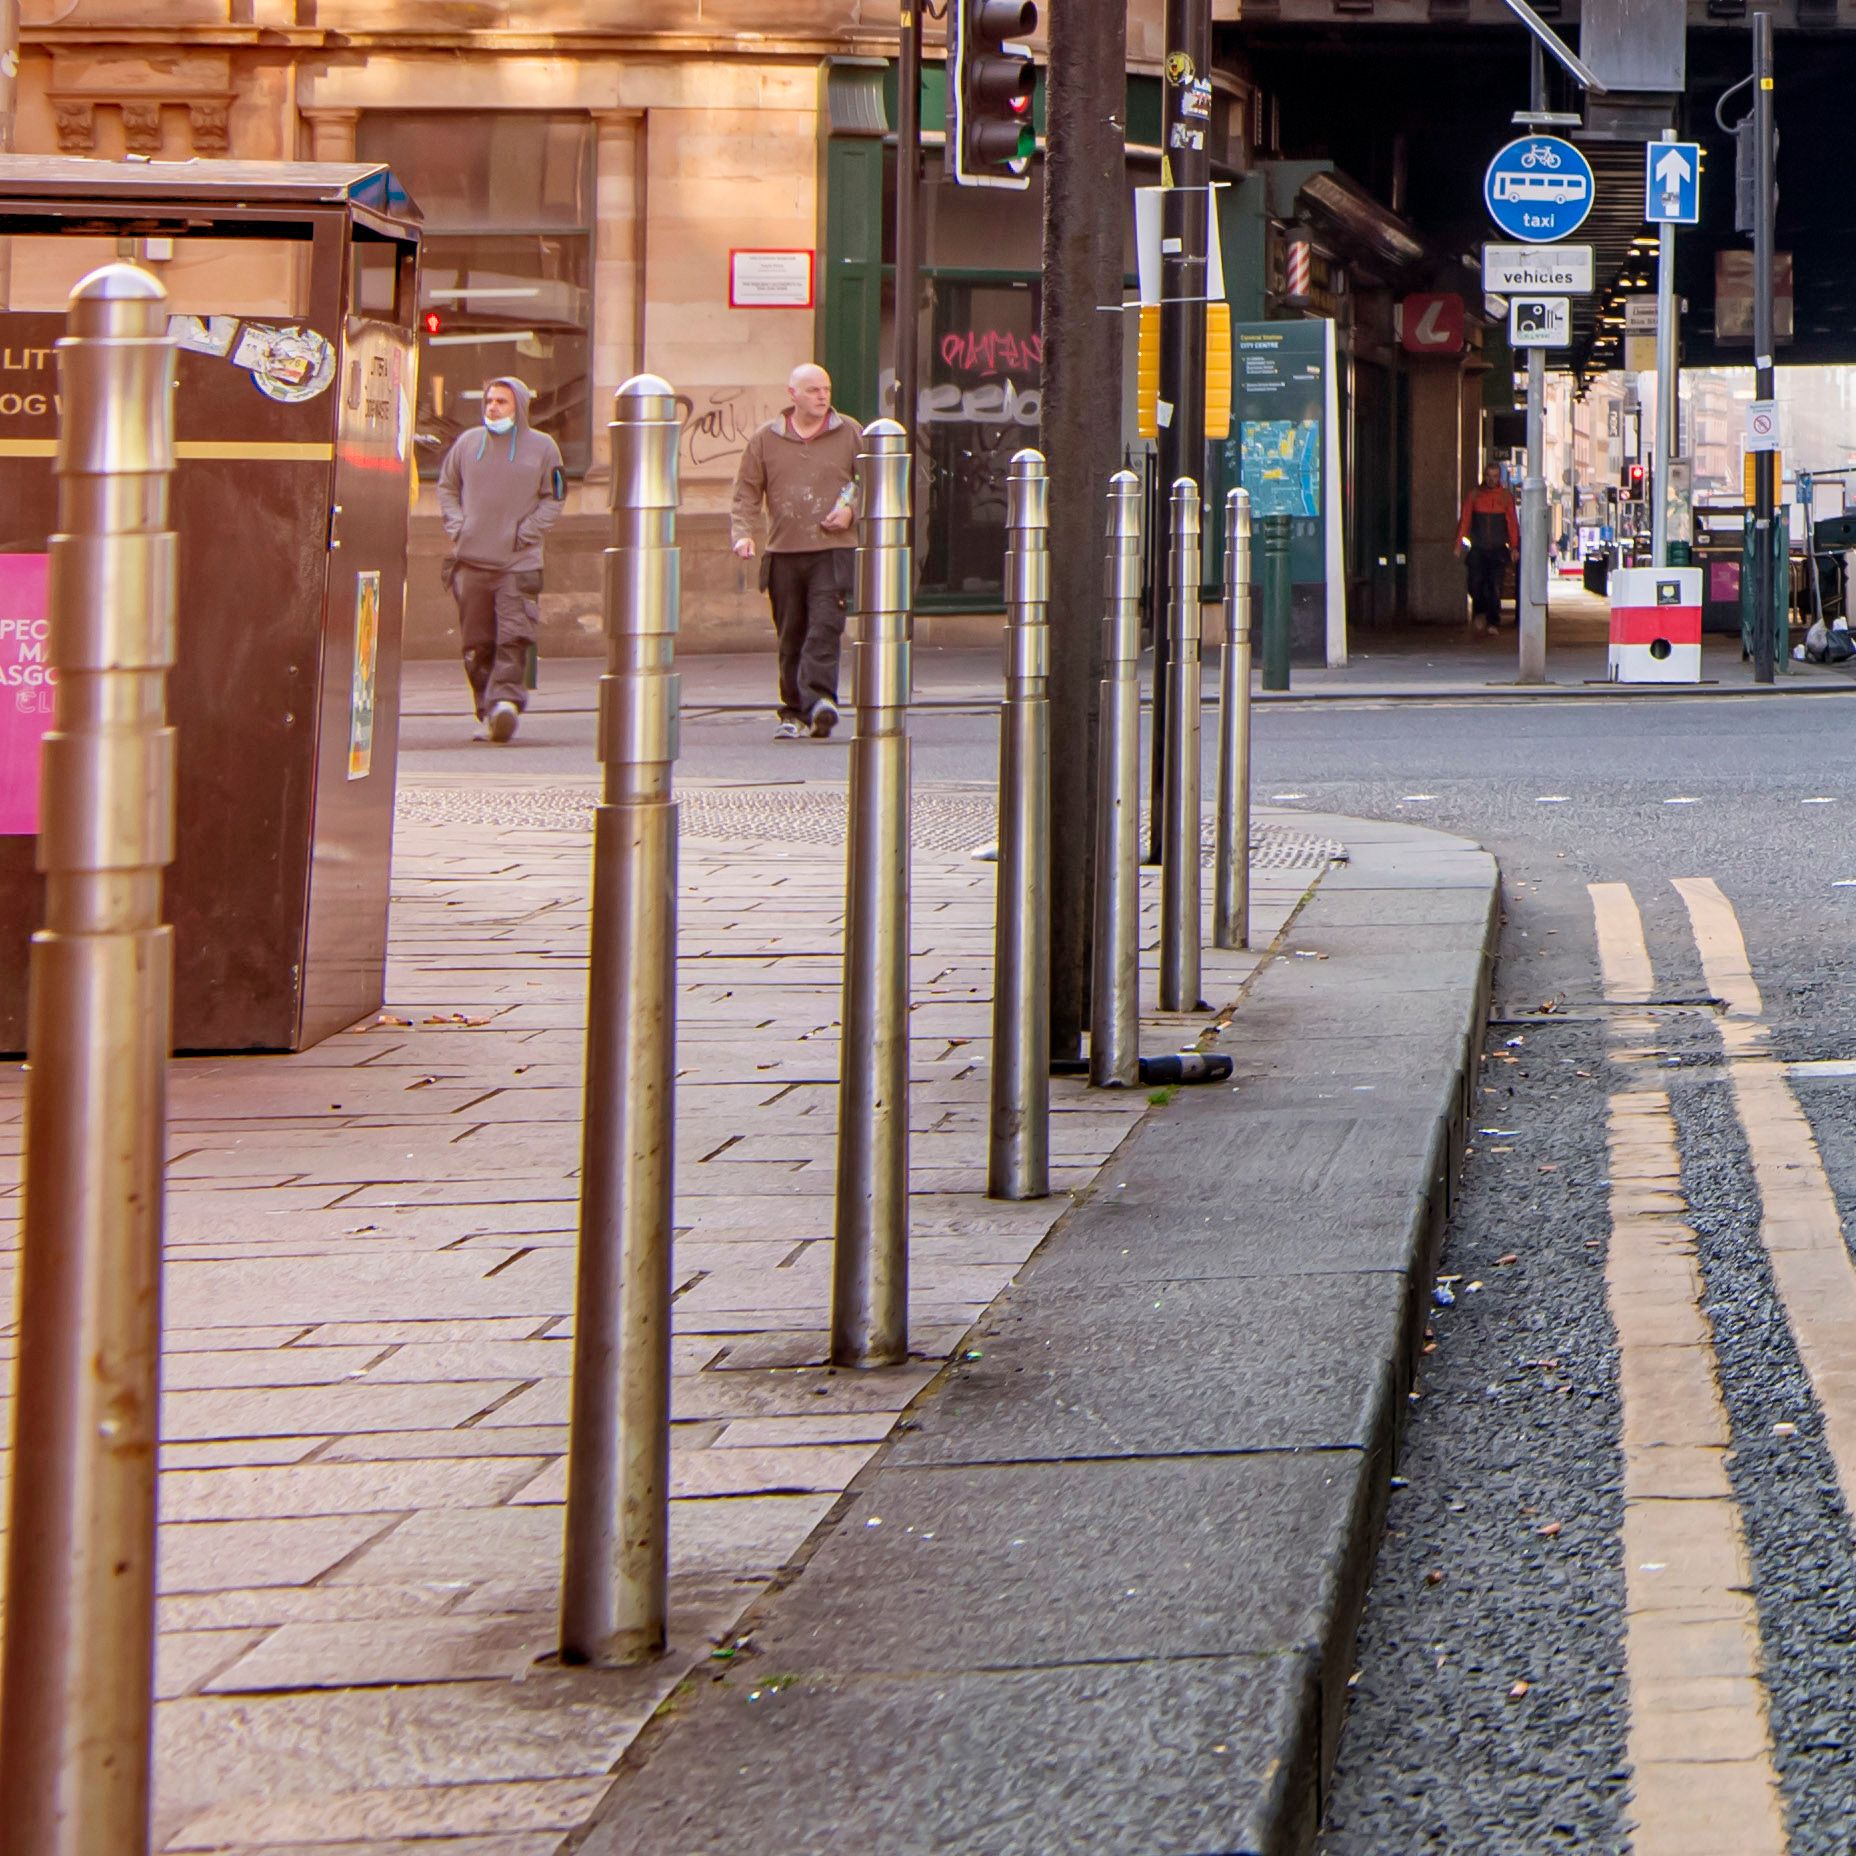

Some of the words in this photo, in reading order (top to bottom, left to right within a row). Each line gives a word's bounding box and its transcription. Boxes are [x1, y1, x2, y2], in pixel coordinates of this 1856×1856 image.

[1523, 212, 1555, 228] taxi
[1503, 270, 1574, 284] vehicles
[4, 348, 65, 370] LITT
[0, 393, 47, 415] OG
